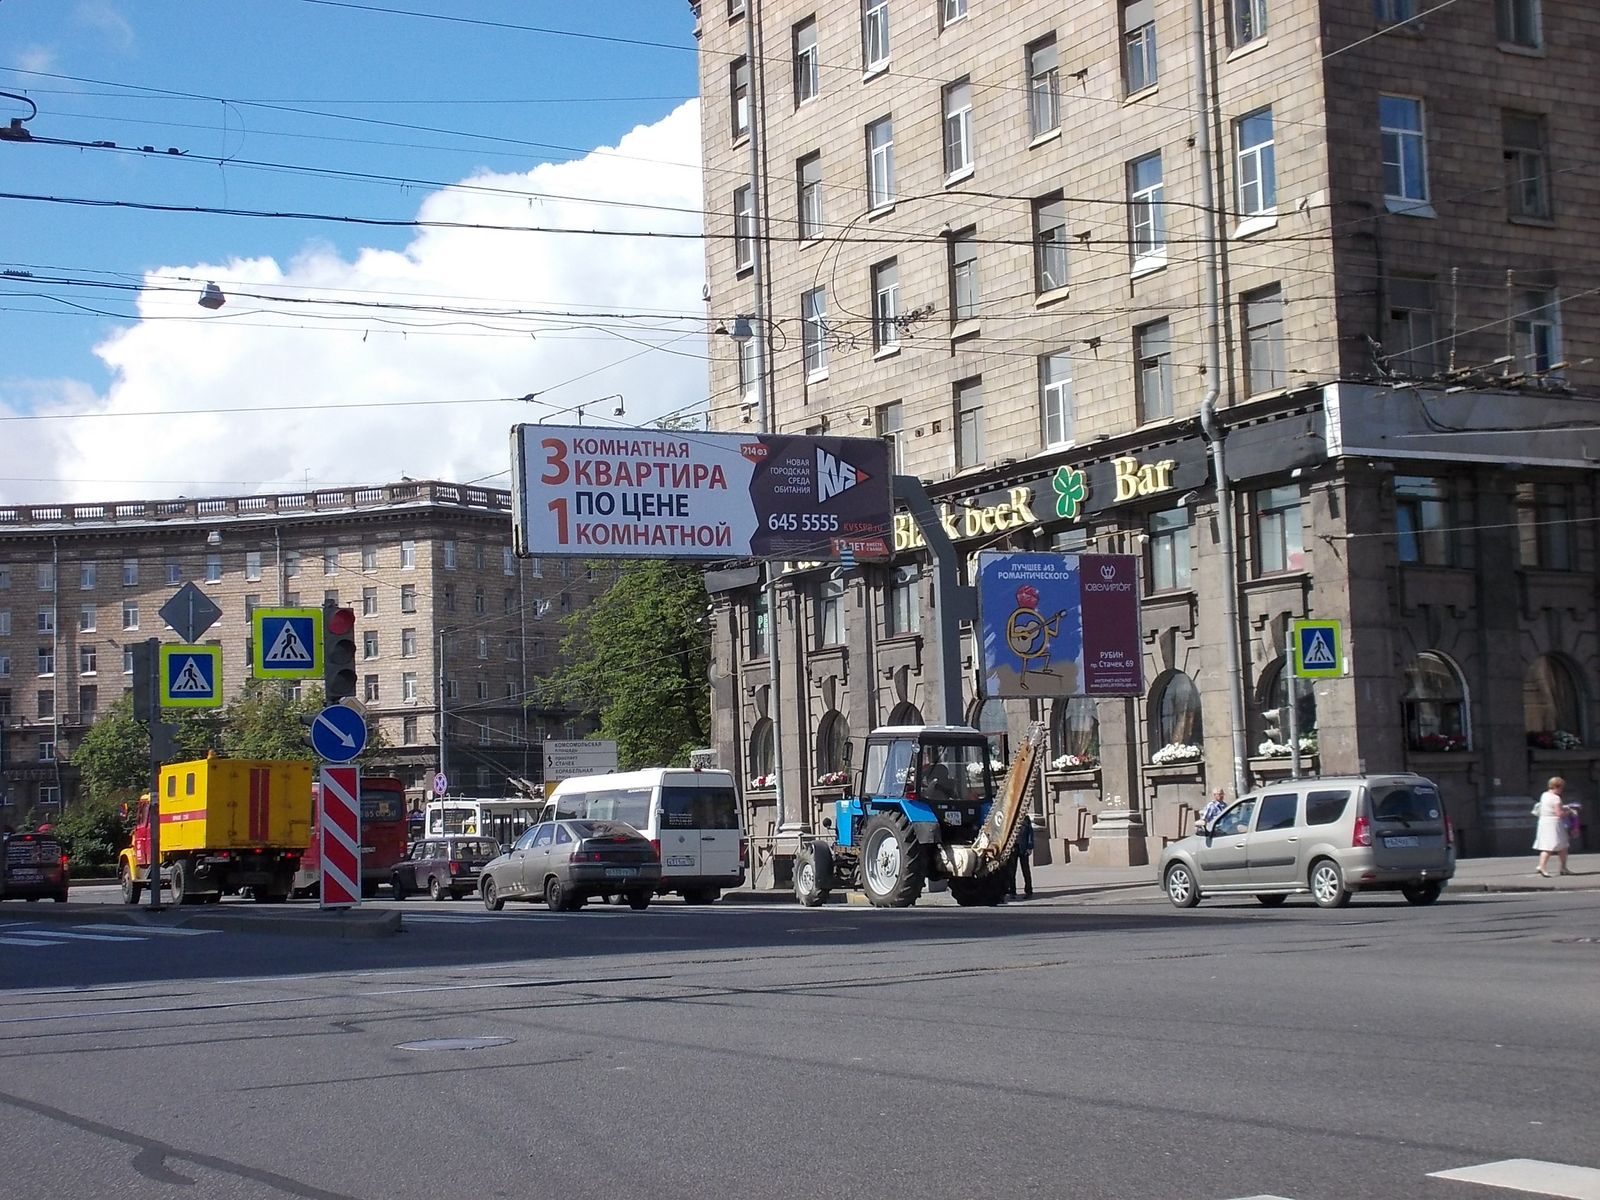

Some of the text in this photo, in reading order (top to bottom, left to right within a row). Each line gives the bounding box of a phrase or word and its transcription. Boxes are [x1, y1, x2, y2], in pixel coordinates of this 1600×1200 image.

[573, 438, 690, 459] КОМНАТНАЯ
[541, 438, 570, 486] 3
[786, 458, 810, 467] НОВАЯ
[575, 460, 728, 490] КВАРТИРА
[770, 467, 810, 476] ГОРОДСКАЯ
[788, 477, 811, 485] СРЕДА
[774, 486, 811, 494] ОБИТАНИЯ
[576, 491, 690, 522] ПО ЦЕНЕ
[894, 502, 962, 551] Blak
[1111, 456, 1176, 502] Bar
[548, 497, 569, 545] 1
[768, 513, 839, 532] 645 5555
[577, 521, 732, 547] КОМНАТНОЙ
[1011, 563, 1056, 572] ЛУЧШЕЕ ИЗ
[998, 571, 1069, 580] РОМАНТИЧЕСКОГО
[1100, 651, 1124, 659] РУБИН
[1125, 660, 1134, 668] 69
